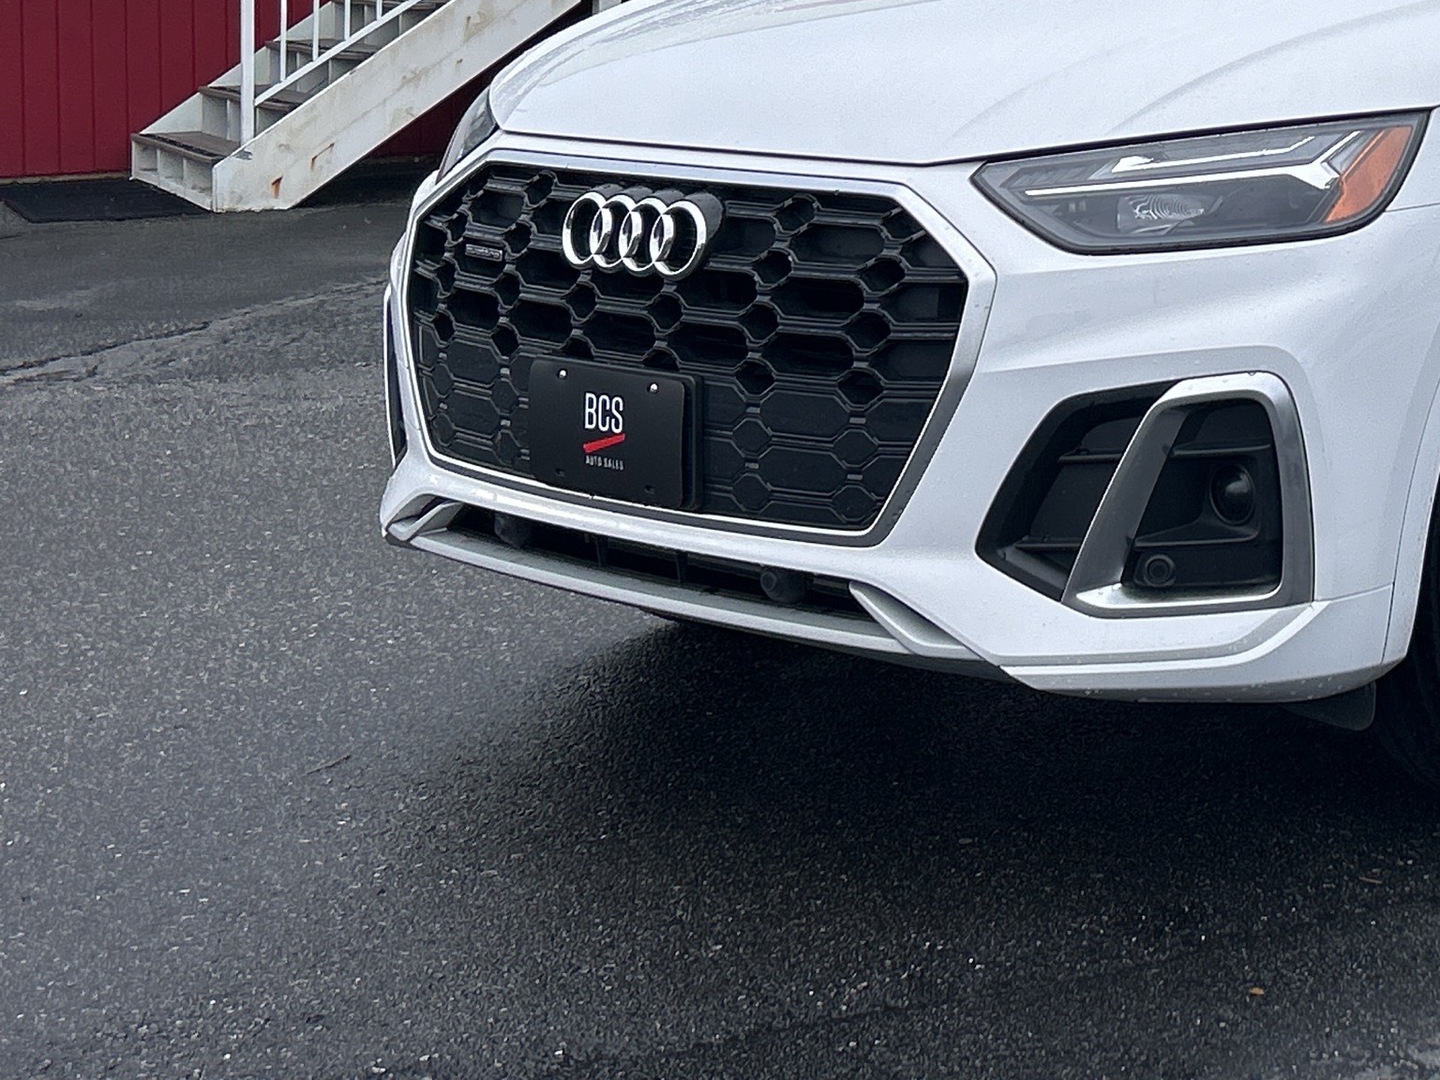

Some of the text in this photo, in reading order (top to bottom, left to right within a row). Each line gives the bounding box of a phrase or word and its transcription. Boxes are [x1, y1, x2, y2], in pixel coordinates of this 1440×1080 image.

[585, 393, 625, 433] BCS
[586, 455, 624, 470] AUTO SALES
